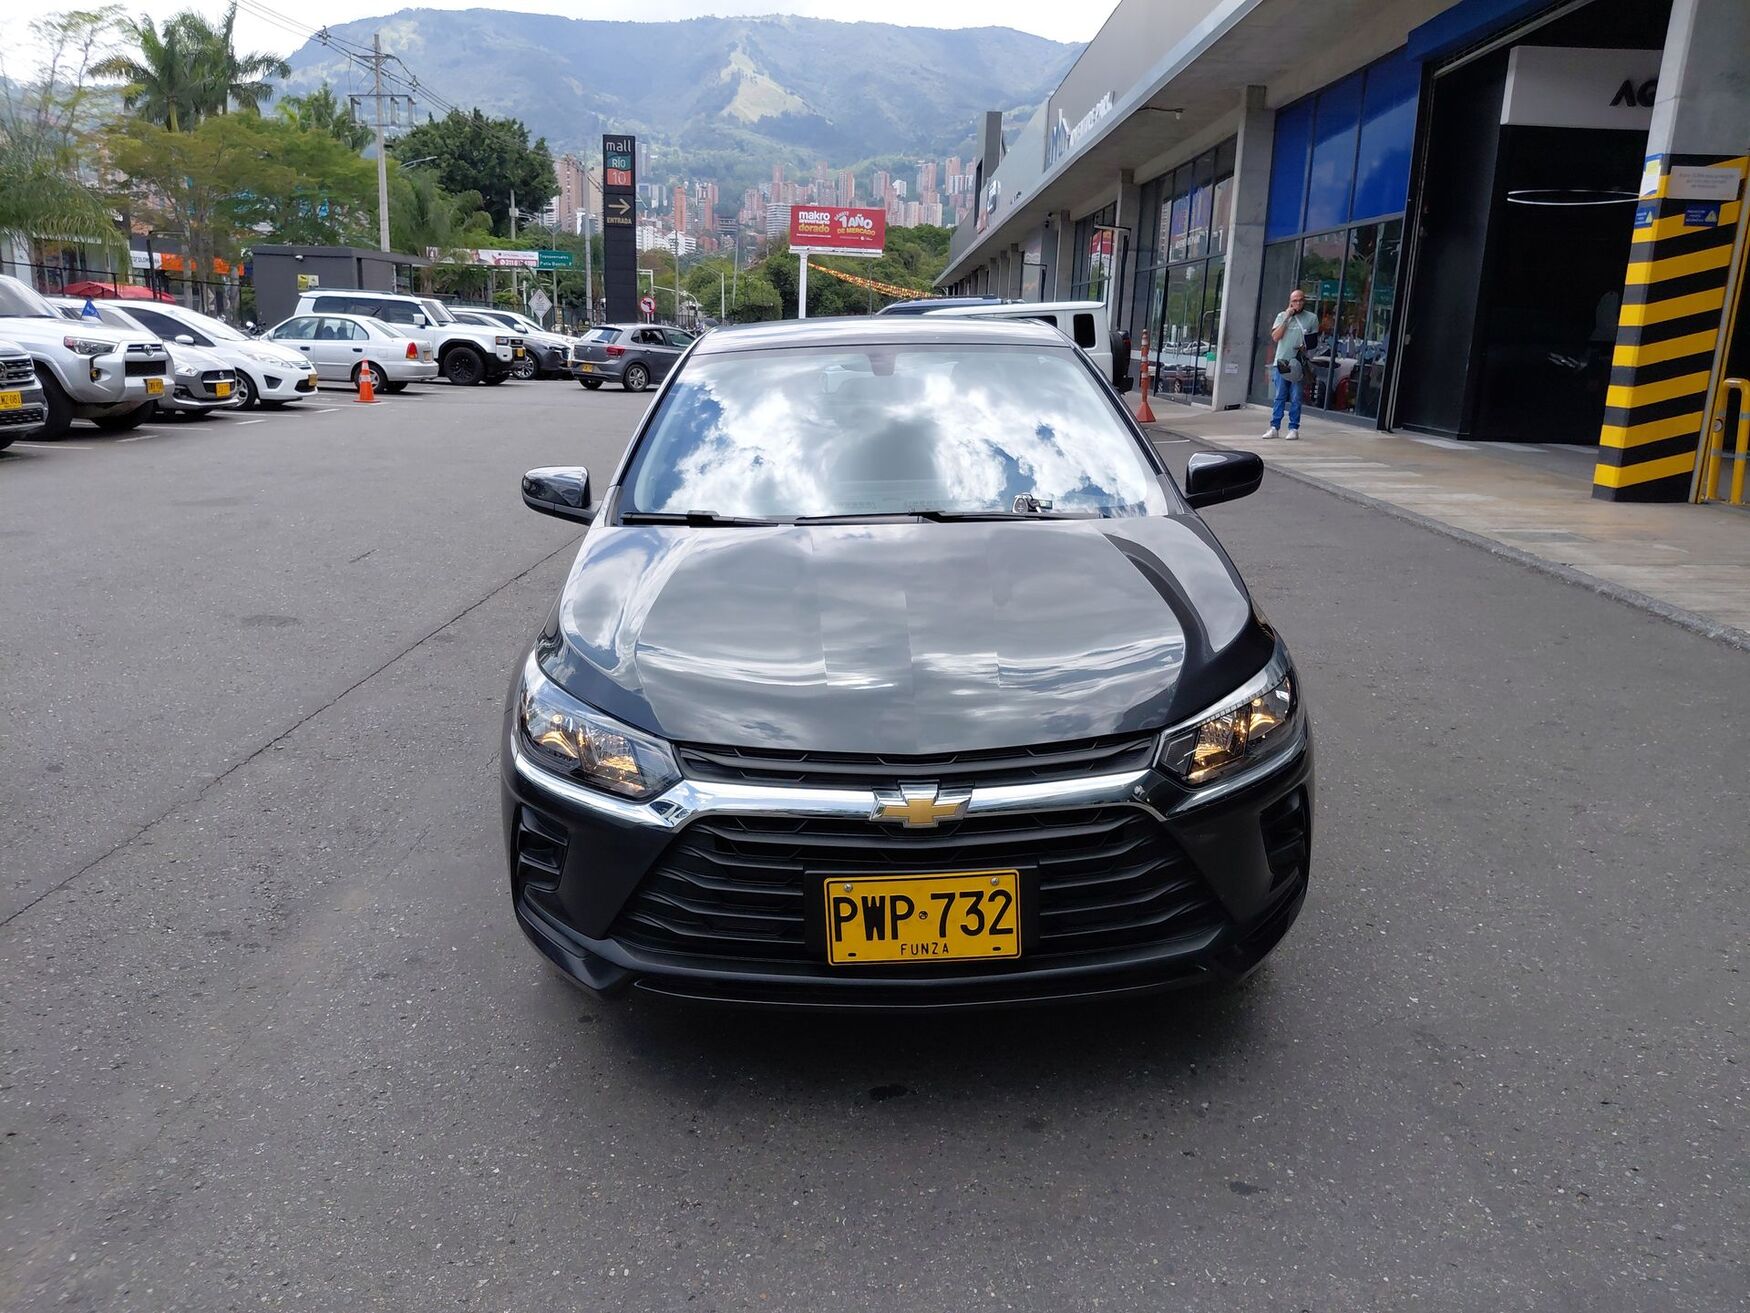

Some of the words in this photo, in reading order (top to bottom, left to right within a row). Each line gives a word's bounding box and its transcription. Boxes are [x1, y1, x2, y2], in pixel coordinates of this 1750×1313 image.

[606, 140, 631, 152] mall
[612, 172, 627, 185] 10
[606, 217, 632, 225] ENTRADA
[798, 210, 830, 220] makro
[848, 213, 873, 229] AÑO
[798, 223, 830, 233] dorado
[900, 942, 949, 956] FUNZA
